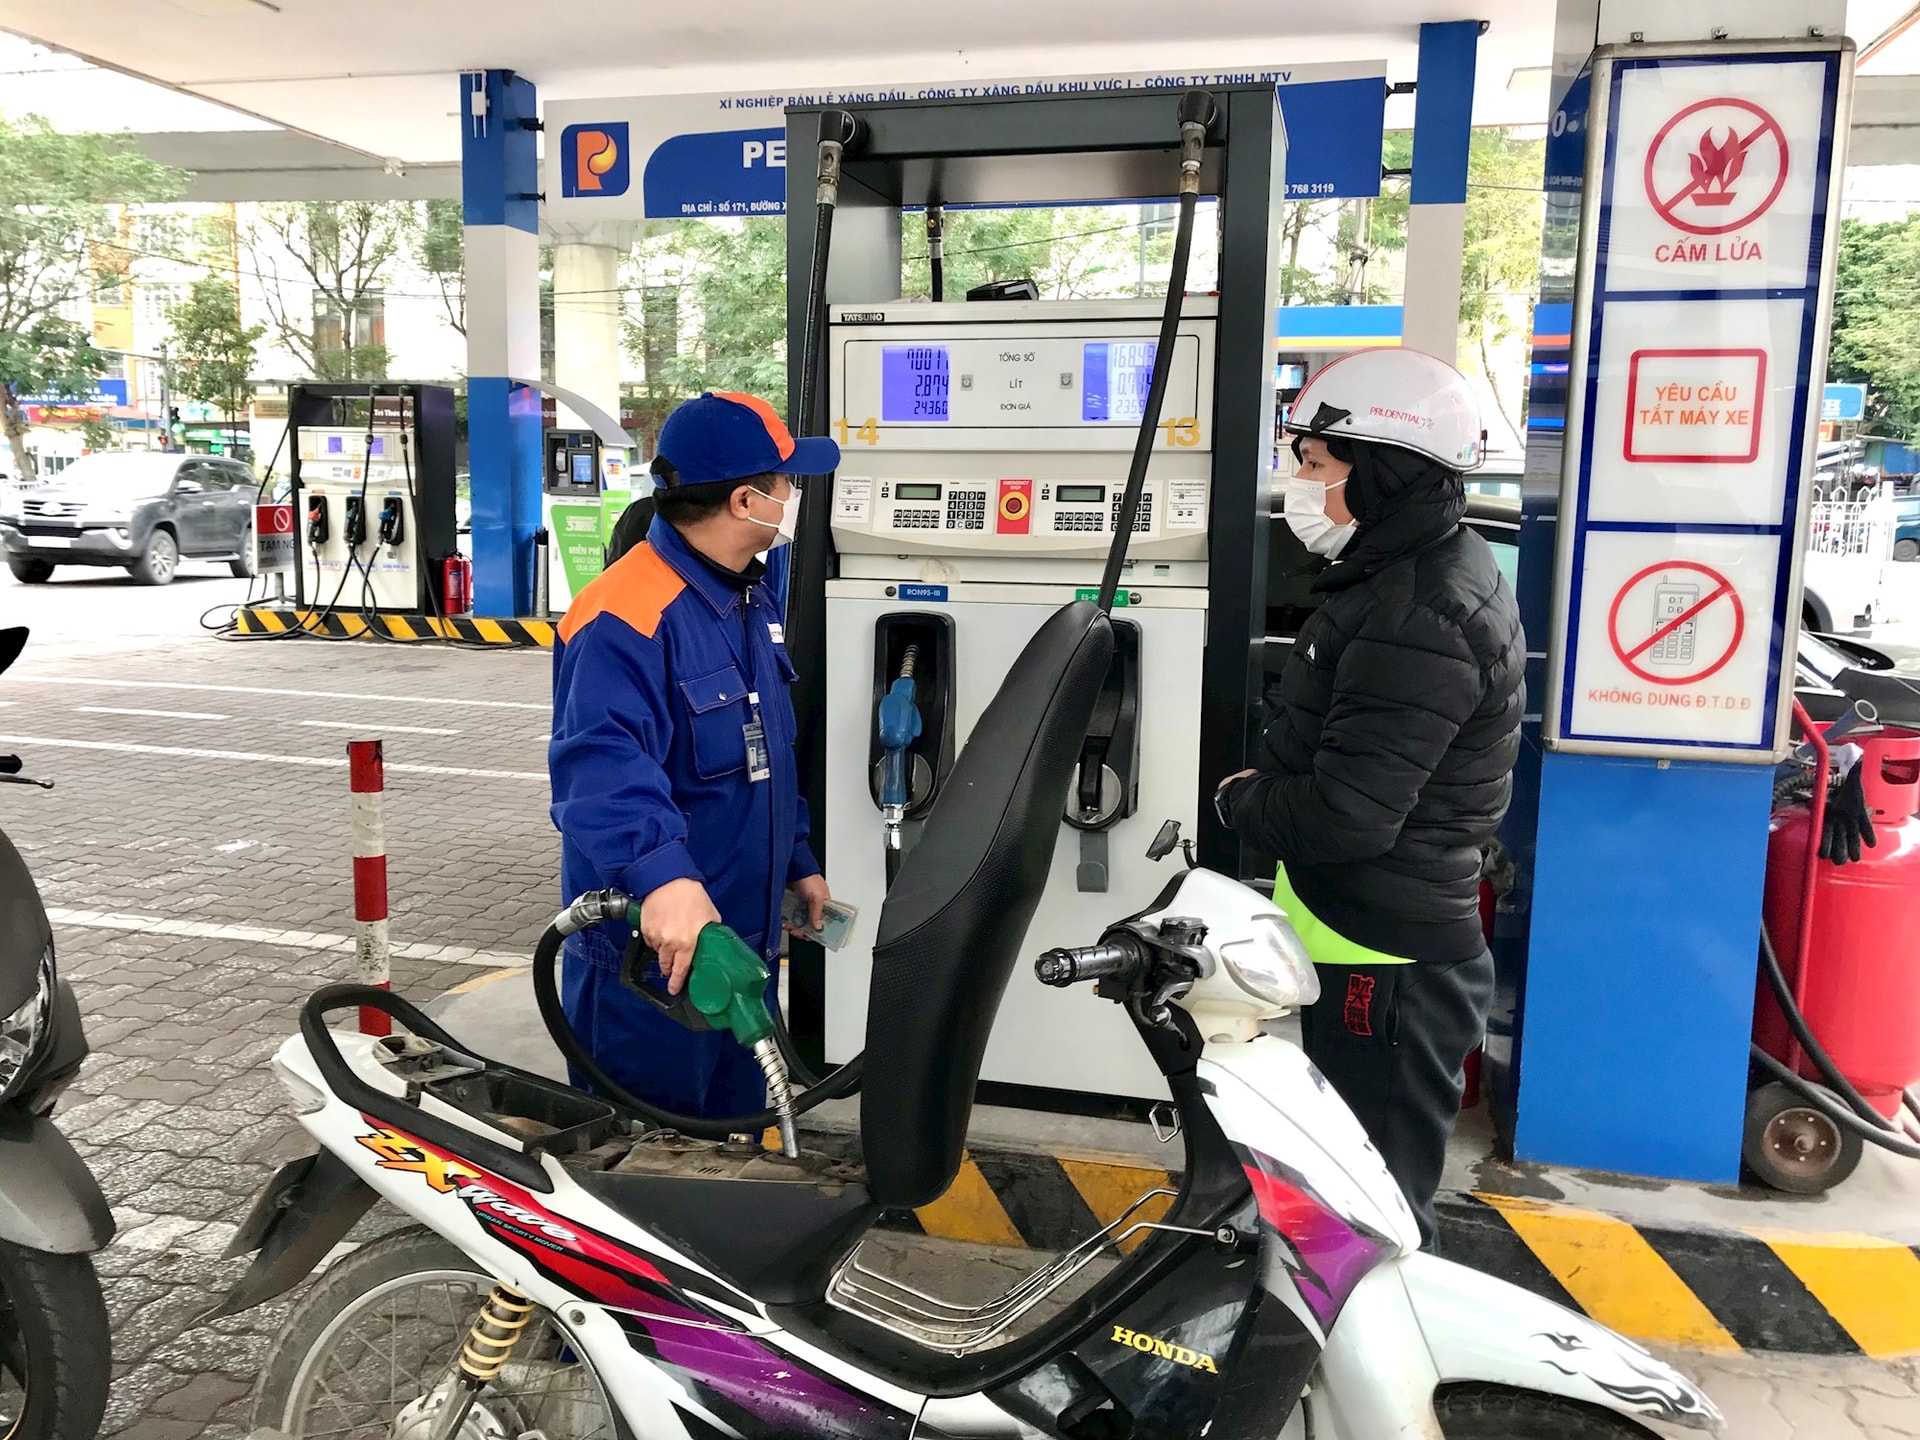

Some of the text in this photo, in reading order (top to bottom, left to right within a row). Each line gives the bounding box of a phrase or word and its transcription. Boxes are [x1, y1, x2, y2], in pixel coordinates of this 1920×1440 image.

[720, 97, 732, 109] XÍ
[736, 95, 784, 109] NGHIỆP
[788, 93, 814, 105] BÁN
[839, 91, 874, 103] XĂNG
[918, 88, 956, 99] CÔNG
[961, 87, 978, 97] TY
[983, 83, 1020, 96] XĂNG
[1058, 81, 1088, 92] KHU
[1145, 75, 1186, 88] CÔNG
[1190, 75, 1210, 86] TY
[1214, 73, 1255, 85] TNHH
[1260, 71, 1292, 82] MTV
[1291, 184, 1309, 194] 768
[1311, 183, 1335, 194] 3119
[682, 203, 696, 214] ĐỊA
[697, 201, 713, 213] CHỈ
[718, 200, 730, 212] SỐ
[732, 203, 749, 214] 171,
[1655, 235, 1763, 262] CẤM LỬA
[843, 313, 883, 321] TATSUNO
[1009, 378, 1023, 389] LÍT
[1656, 380, 1737, 402] YÊU CẦU
[914, 401, 948, 414] 24360
[1018, 401, 1032, 410] GIÁ
[1640, 403, 1748, 425] TẮT MÁY XE
[1370, 406, 1420, 425] PRUDENTIAL
[833, 418, 880, 445] 14
[1159, 417, 1200, 446] 13
[906, 589, 941, 597] RON95-III
[1668, 596, 1684, 605] Đ.T
[1667, 606, 1684, 614] D.Đ
[1588, 687, 1643, 705] KHÔNG
[475, 1210, 564, 1252] URBAN SPORTY MOVER
[1110, 1325, 1219, 1375] HONDA
